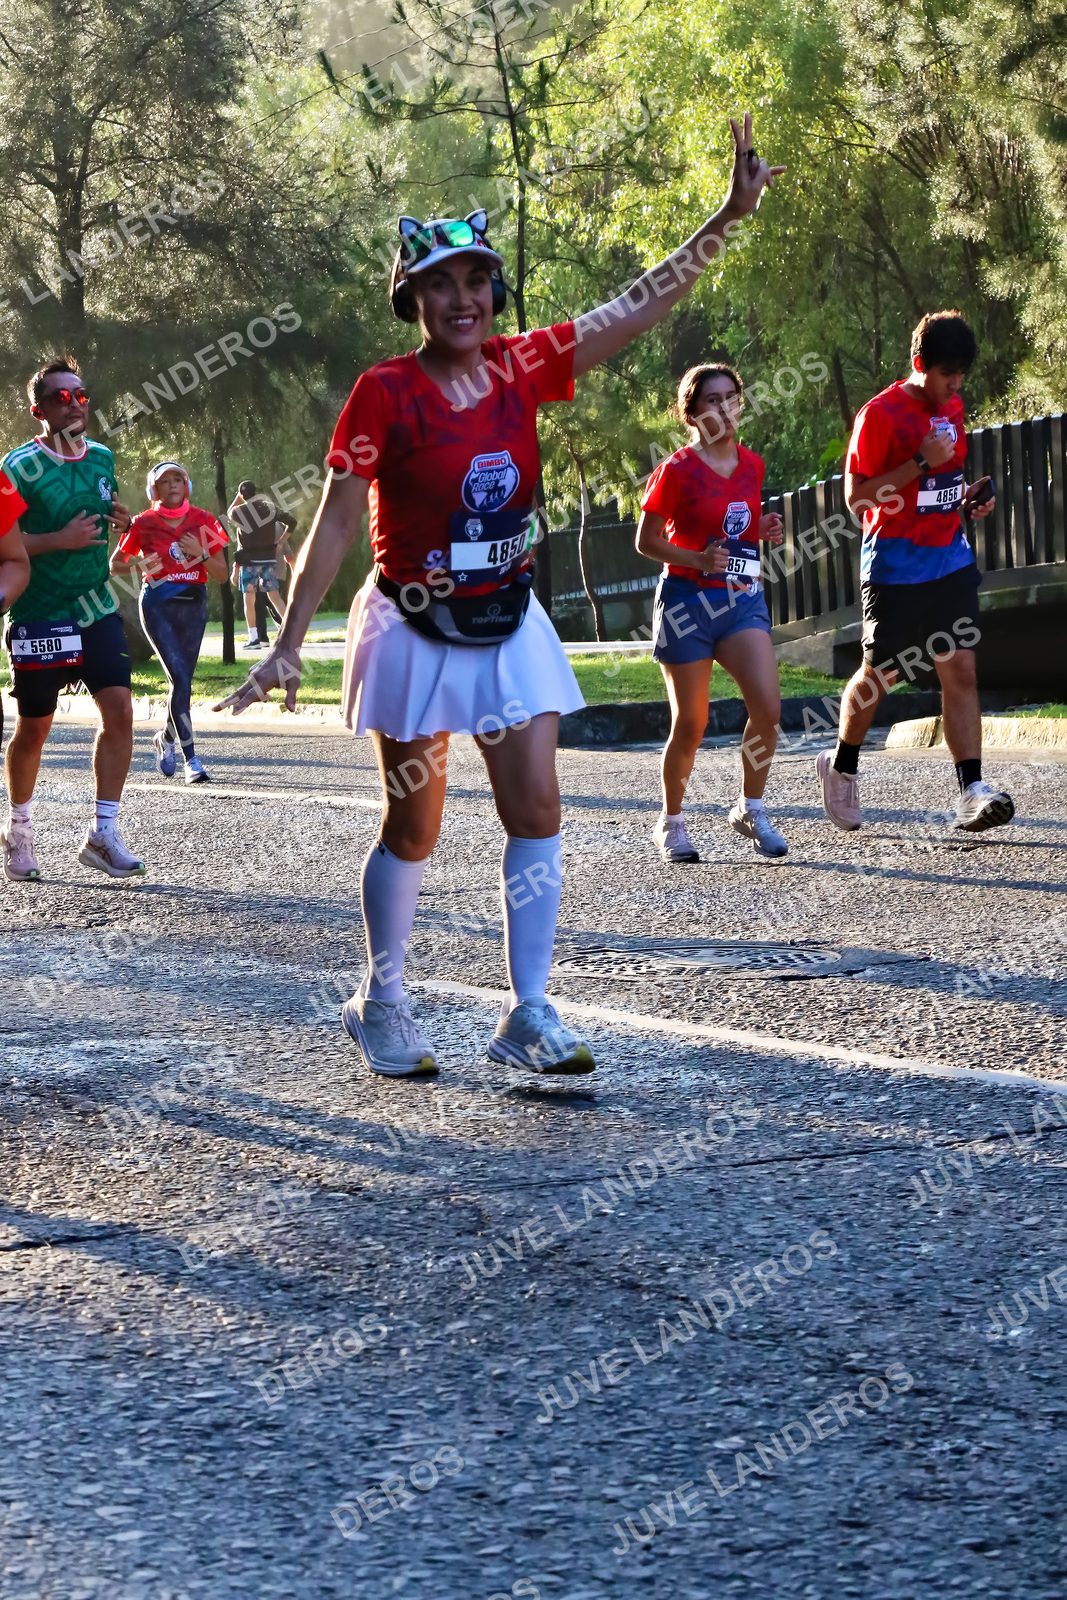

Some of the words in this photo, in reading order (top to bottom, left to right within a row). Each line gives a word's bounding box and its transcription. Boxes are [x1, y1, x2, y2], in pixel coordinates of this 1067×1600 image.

[478, 458, 506, 468] BIMBO
[479, 469, 507, 483] Global
[472, 481, 495, 493] Race
[936, 487, 958, 503] 4856
[488, 532, 526, 565] 4850
[472, 614, 513, 625] TOPTIME
[30, 638, 62, 654] 5580
